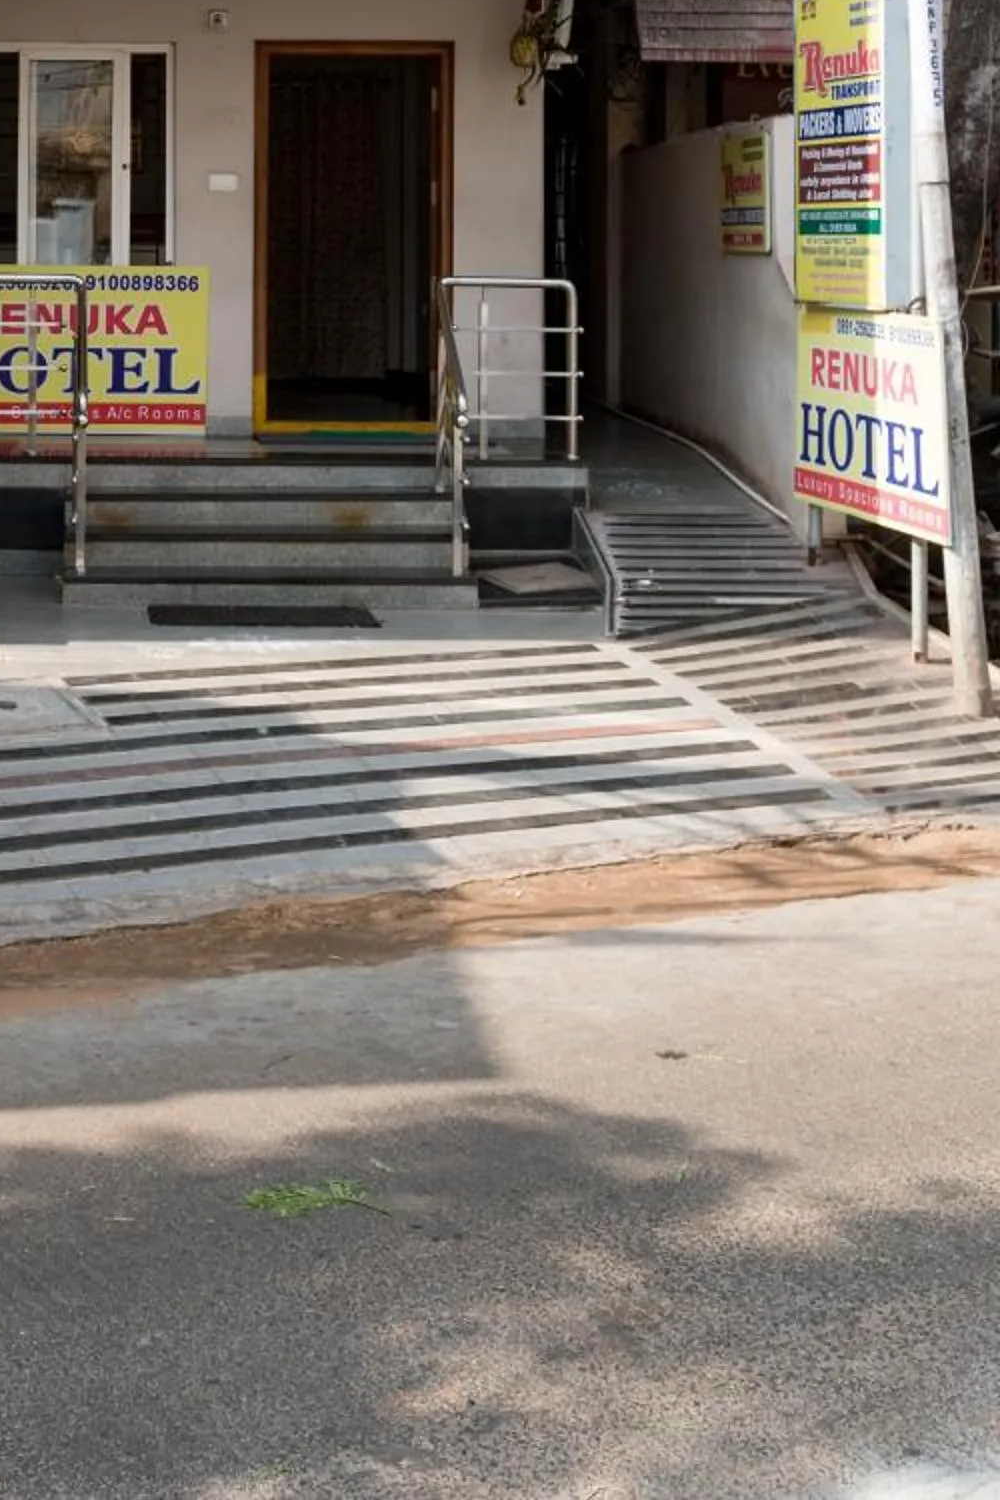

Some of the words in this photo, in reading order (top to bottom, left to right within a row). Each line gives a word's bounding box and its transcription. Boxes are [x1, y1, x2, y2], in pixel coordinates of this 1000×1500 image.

[85, 275, 199, 292] 9100898366
[811, 347, 918, 405] RENUKA
[138, 406, 201, 421] Rooms
[800, 402, 939, 497] HOTEL
